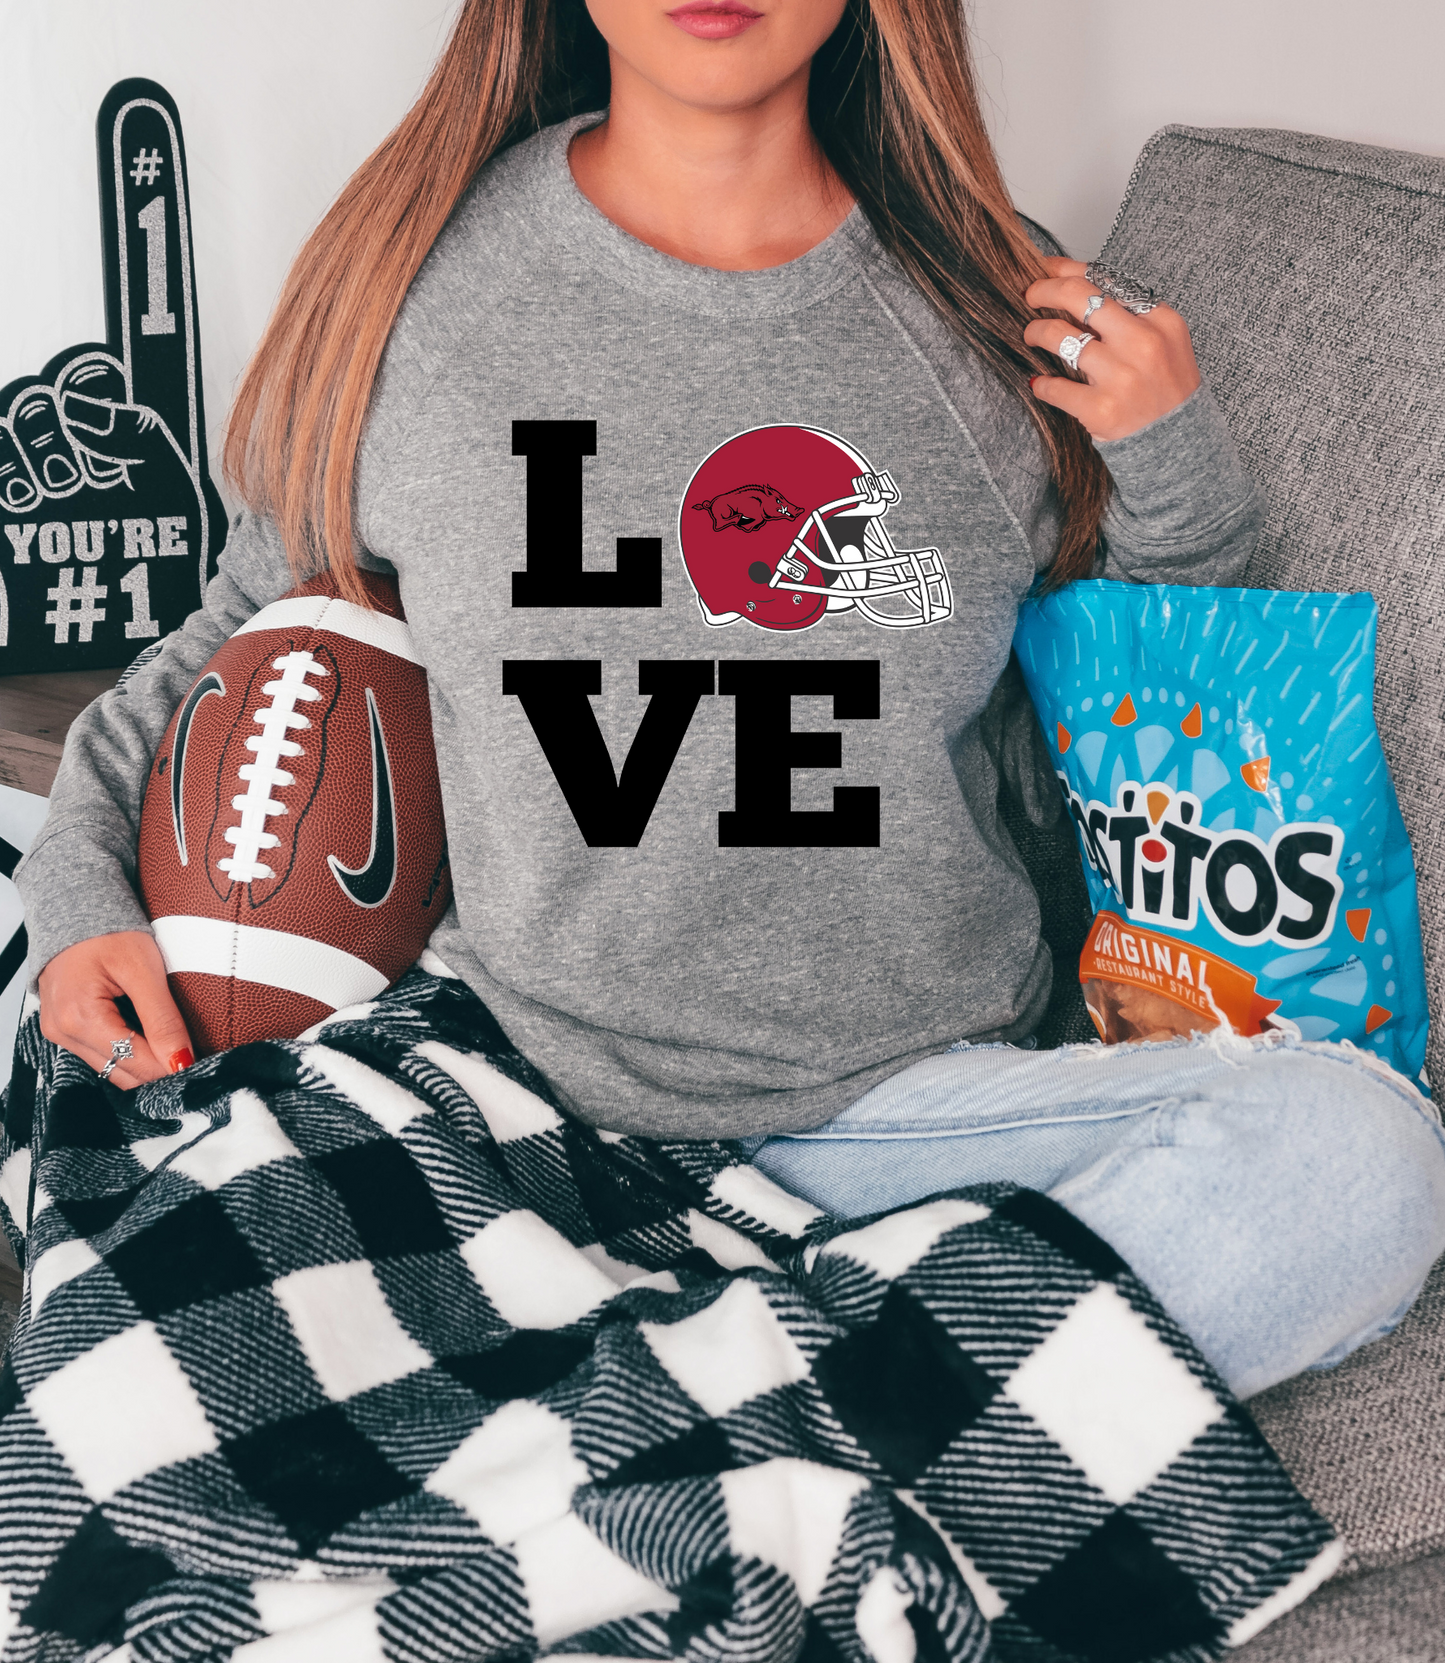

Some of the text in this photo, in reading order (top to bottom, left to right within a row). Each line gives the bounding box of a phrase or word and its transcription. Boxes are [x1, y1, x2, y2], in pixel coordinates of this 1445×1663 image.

[130, 147, 164, 186] #
[138, 196, 176, 335] 1
[4, 516, 189, 564] YOU'RE
[512, 420, 662, 608] L
[45, 562, 160, 644] #1
[502, 660, 880, 848] VE
[1094, 921, 1211, 991] ORIGINAL
[1095, 957, 1207, 1009] RESTAURANT STYLE
